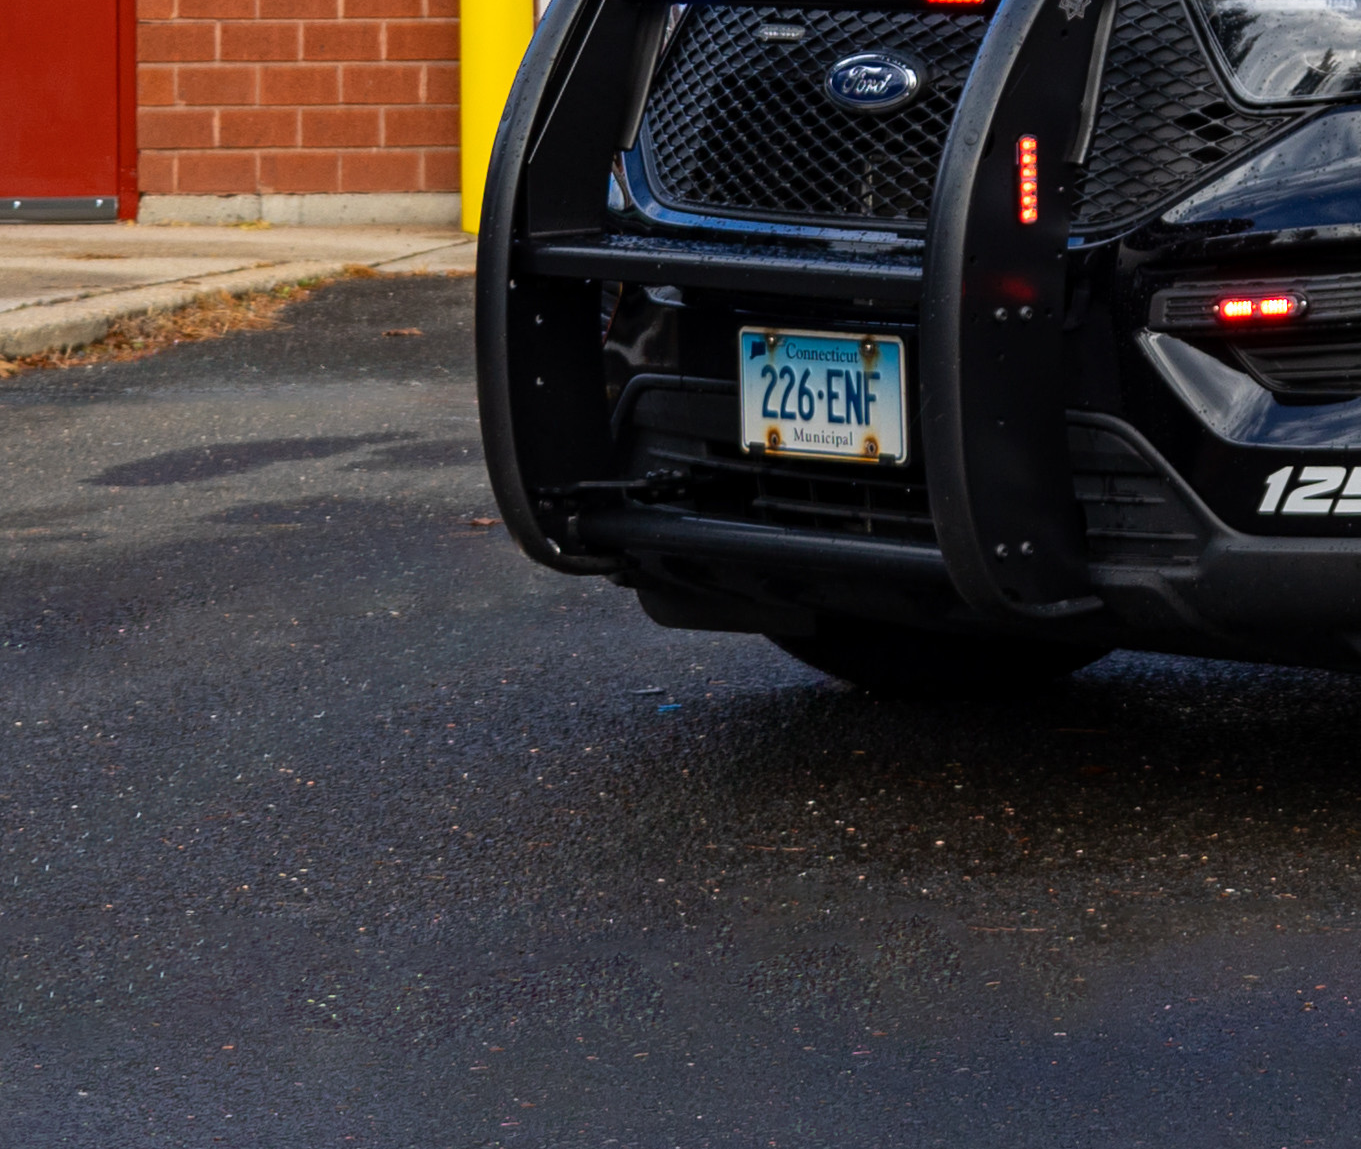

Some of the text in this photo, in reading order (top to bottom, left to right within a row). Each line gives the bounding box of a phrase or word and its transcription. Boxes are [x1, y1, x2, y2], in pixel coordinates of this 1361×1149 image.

[842, 65, 893, 95] Ford
[786, 342, 859, 363] Connecticut
[793, 427, 854, 448] Municipal
